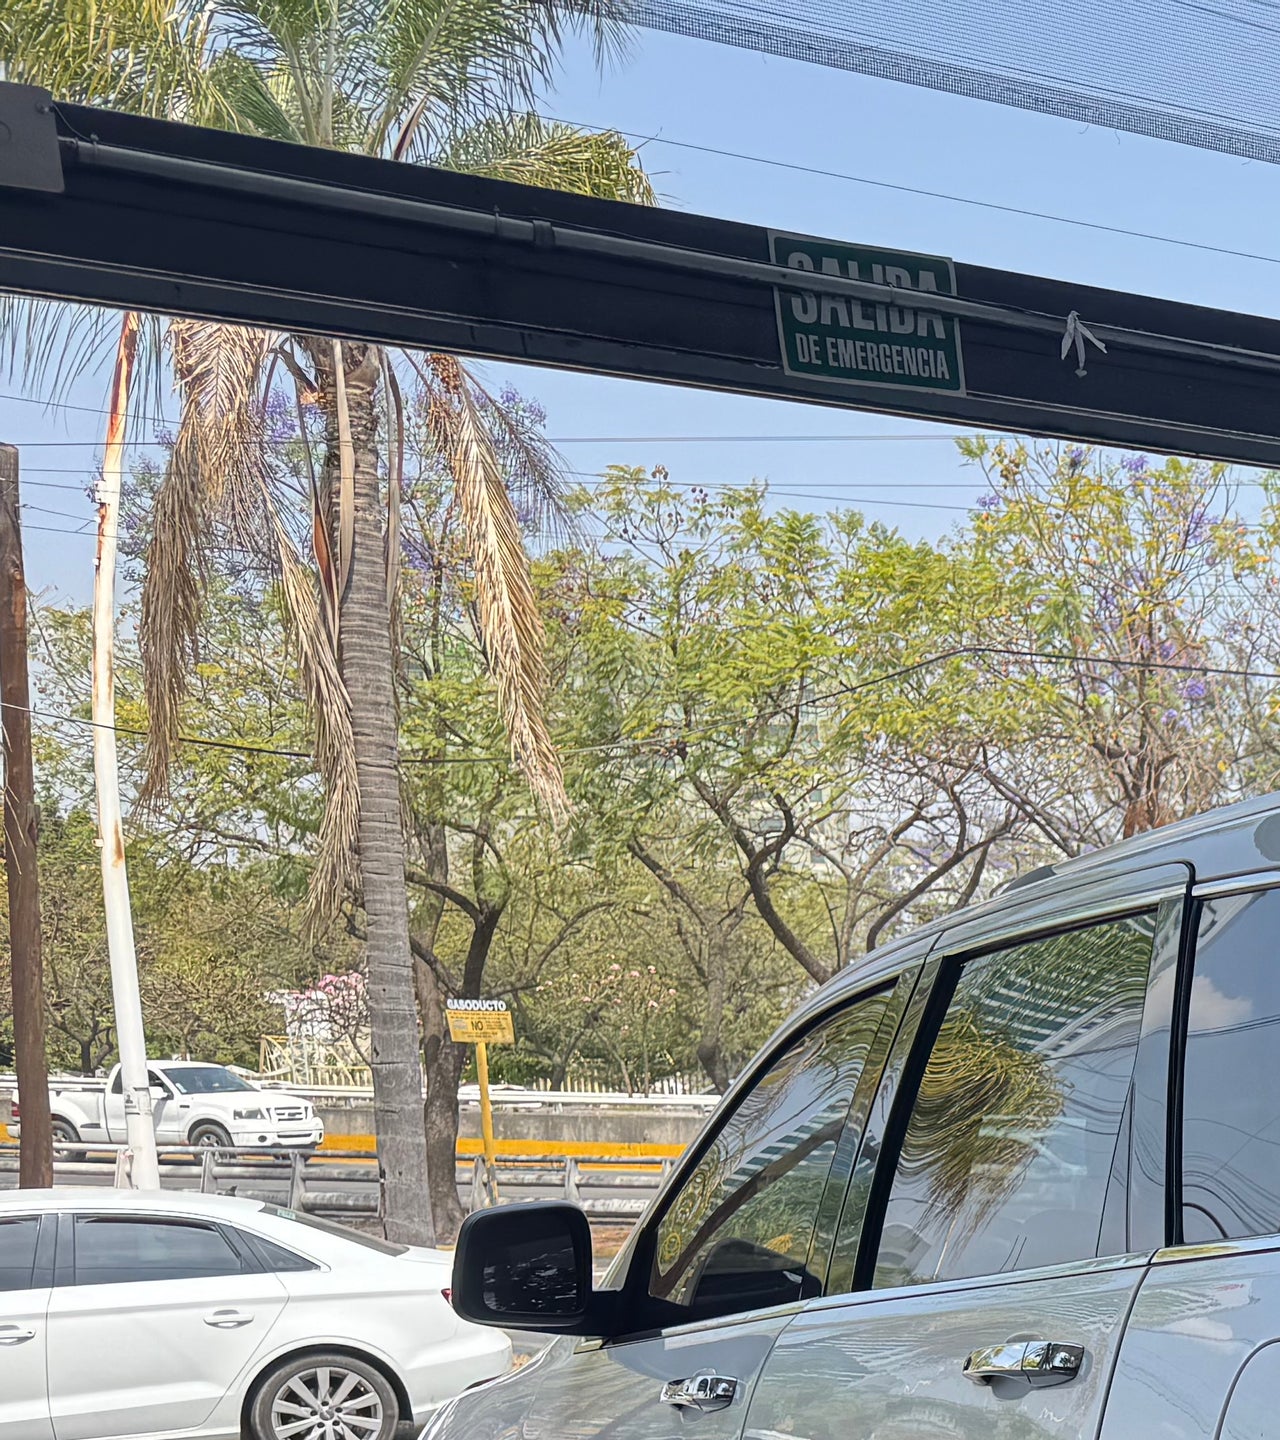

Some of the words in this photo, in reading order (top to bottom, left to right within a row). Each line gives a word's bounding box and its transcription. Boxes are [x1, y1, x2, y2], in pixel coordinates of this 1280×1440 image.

[787, 252, 946, 339] SALIDA
[795, 333, 821, 366] DE
[827, 336, 950, 380] EMERGENCIA
[447, 999, 506, 1011] GASODUCTO
[471, 1021, 483, 1031] NO
